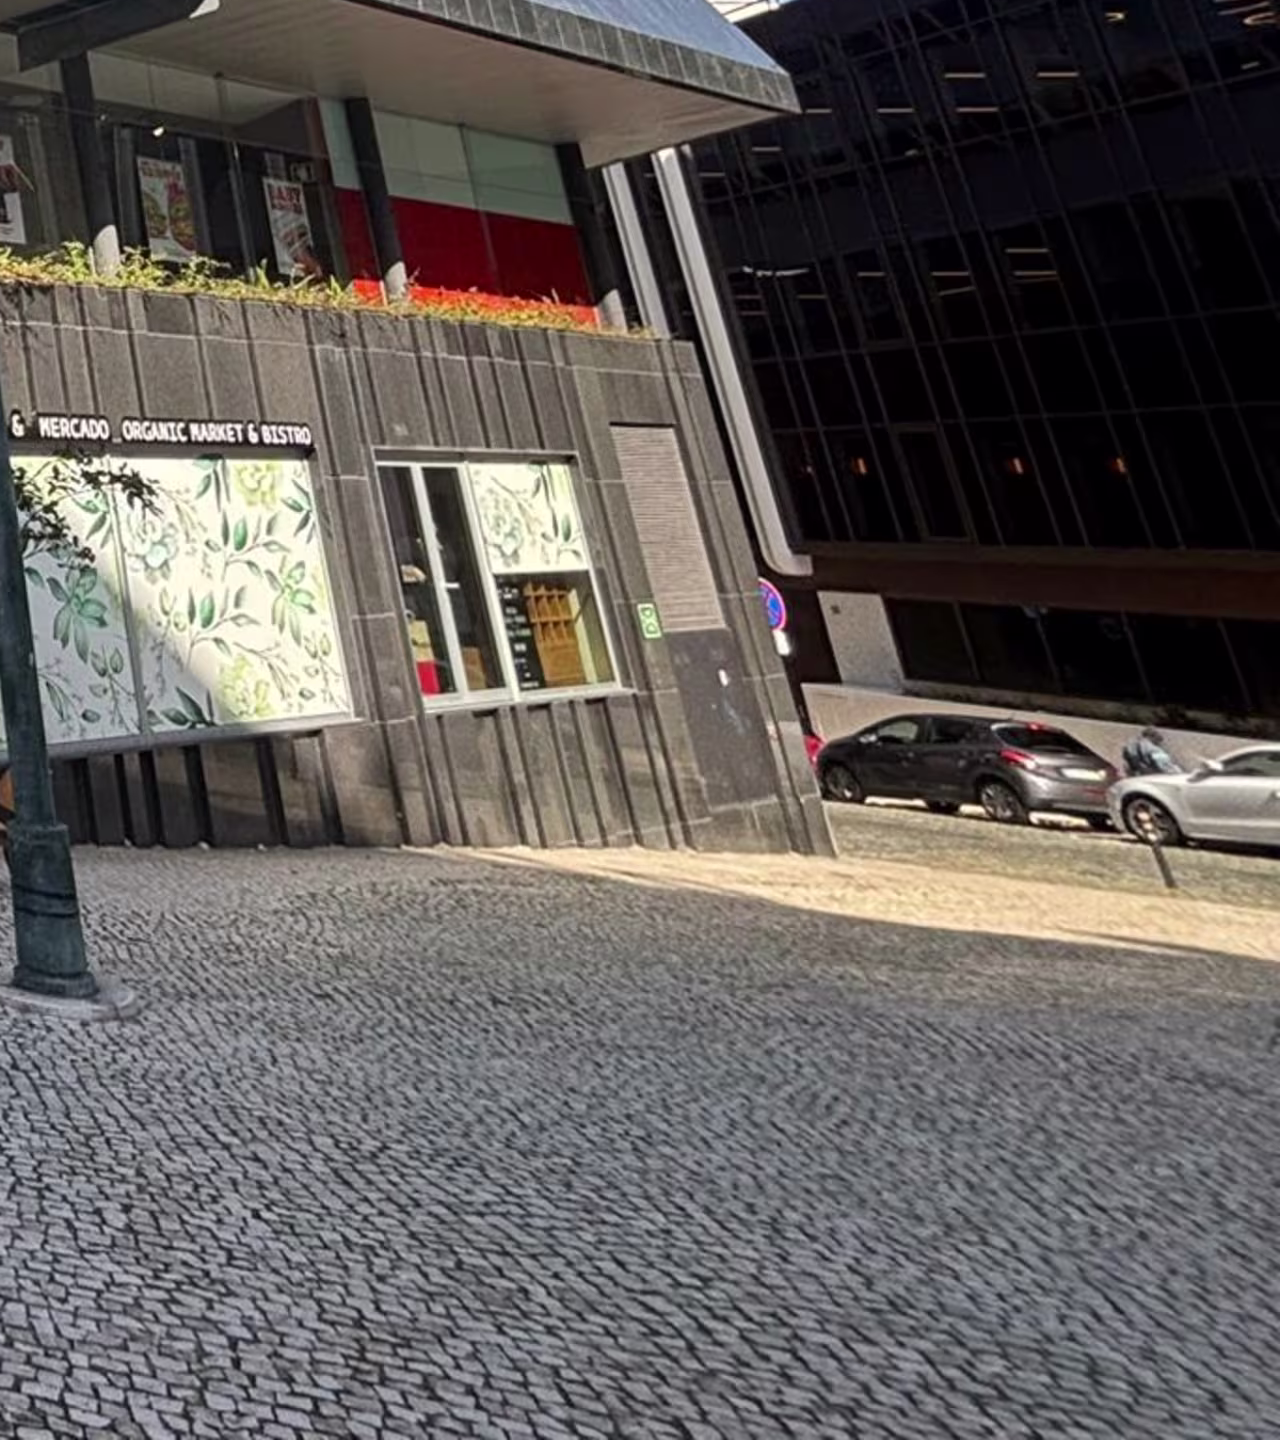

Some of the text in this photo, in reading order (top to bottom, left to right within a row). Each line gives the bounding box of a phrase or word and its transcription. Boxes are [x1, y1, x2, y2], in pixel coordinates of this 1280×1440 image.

[11, 413, 25, 437] &
[39, 417, 110, 440] MERCADO
[122, 419, 187, 442] ORGANIC
[189, 421, 244, 444] MARKET
[247, 422, 259, 444] &
[261, 424, 312, 445] BISTRO
